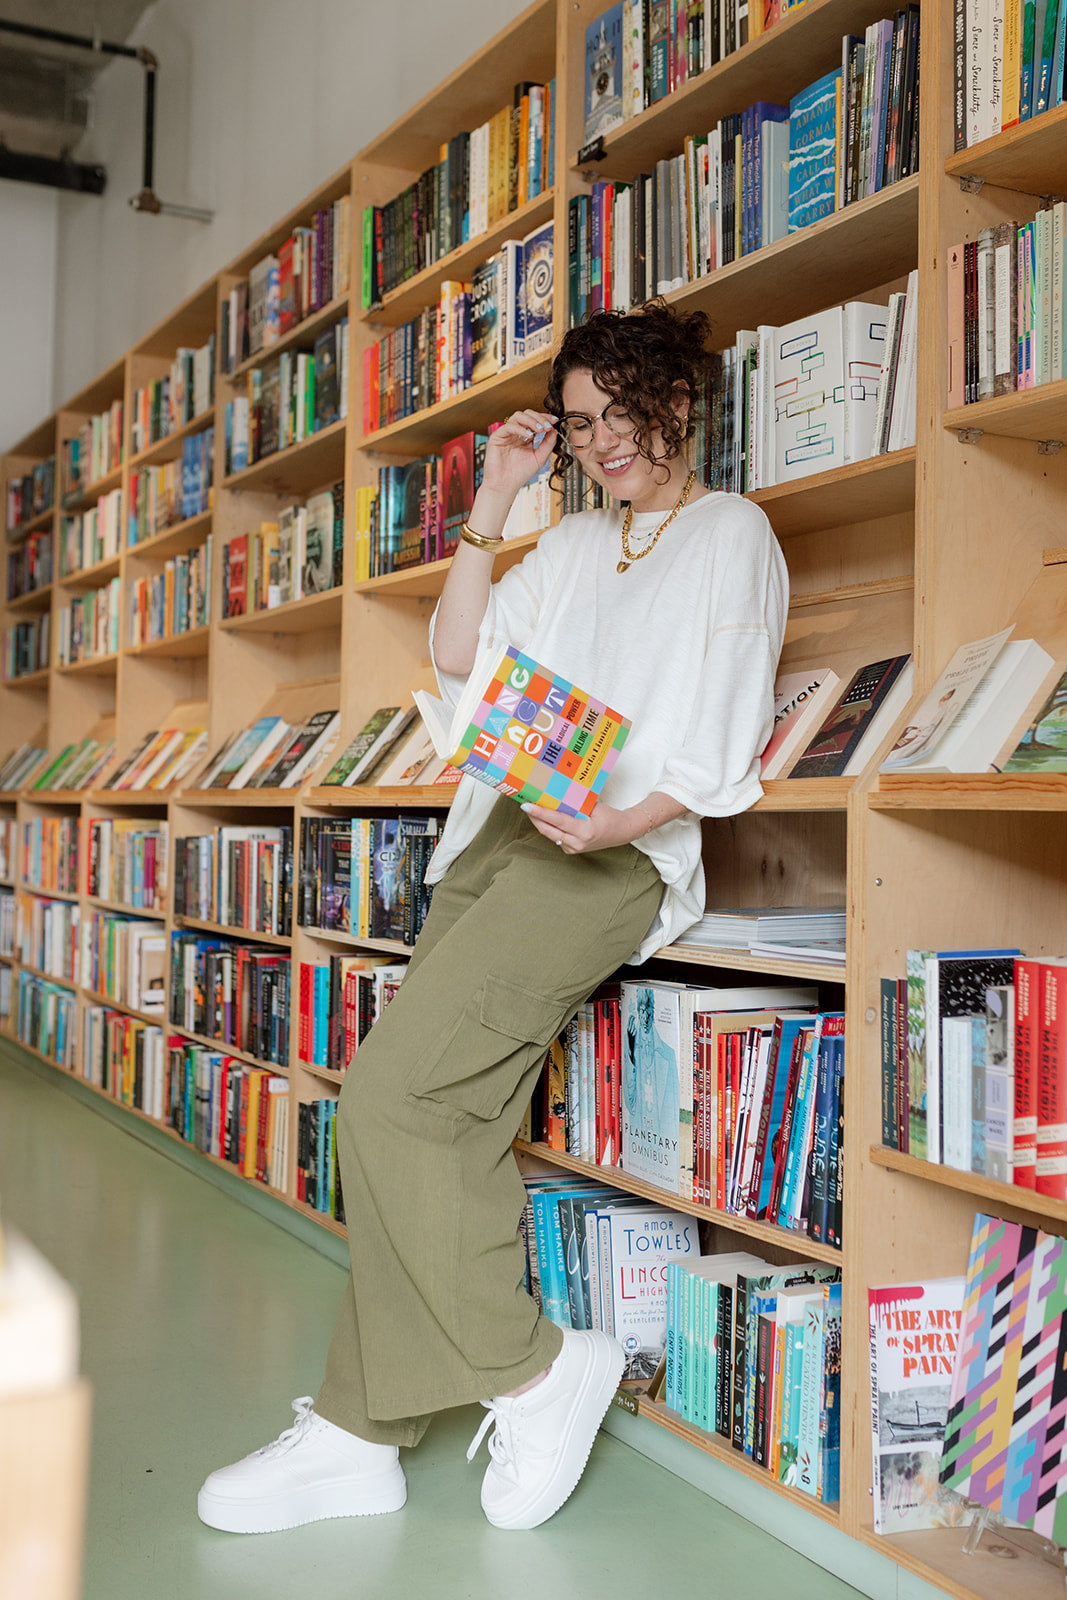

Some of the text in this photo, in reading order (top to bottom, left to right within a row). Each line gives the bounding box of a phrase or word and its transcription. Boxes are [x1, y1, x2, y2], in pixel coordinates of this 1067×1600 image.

[972, 26, 982, 50] Sense
[993, 17, 1002, 41] Sense
[970, 65, 981, 116] Sensibility
[990, 56, 1001, 108] Sensibility
[796, 163, 820, 183] CALL
[794, 176, 834, 206] WHAT W
[799, 200, 832, 226] CARRY
[524, 687, 565, 755] OUT
[542, 698, 582, 765] THE RADICAL POWER
[572, 708, 600, 755] KILLING TIME
[461, 763, 519, 796] HANGING OUT
[764, 1034, 780, 1098] SOPHIE'S
[1016, 1025, 1024, 1078] MARCH
[1041, 1029, 1051, 1121] MARCH 1917
[624, 1123, 678, 1151] PLANETARY
[755, 1104, 770, 1156] WORLD
[782, 1108, 792, 1142] Macbeth
[631, 1142, 669, 1166] OMNIBUS
[815, 1115, 827, 1172] DUNE
[526, 1204, 535, 1238] AGAINST
[644, 1221, 674, 1231] AMOR
[539, 1230, 547, 1268] HANKS
[556, 1233, 564, 1272] HANKS
[623, 1227, 691, 1255] TOWLES
[882, 1309, 962, 1331] THE ART
[886, 1336, 900, 1347] OF
[802, 1358, 810, 1396] CUATRO
[809, 1344, 817, 1391] KRISTIN
[871, 1362, 877, 1372] OF
[903, 1355, 956, 1378] PAIN
[746, 1409, 754, 1448] GREEN
